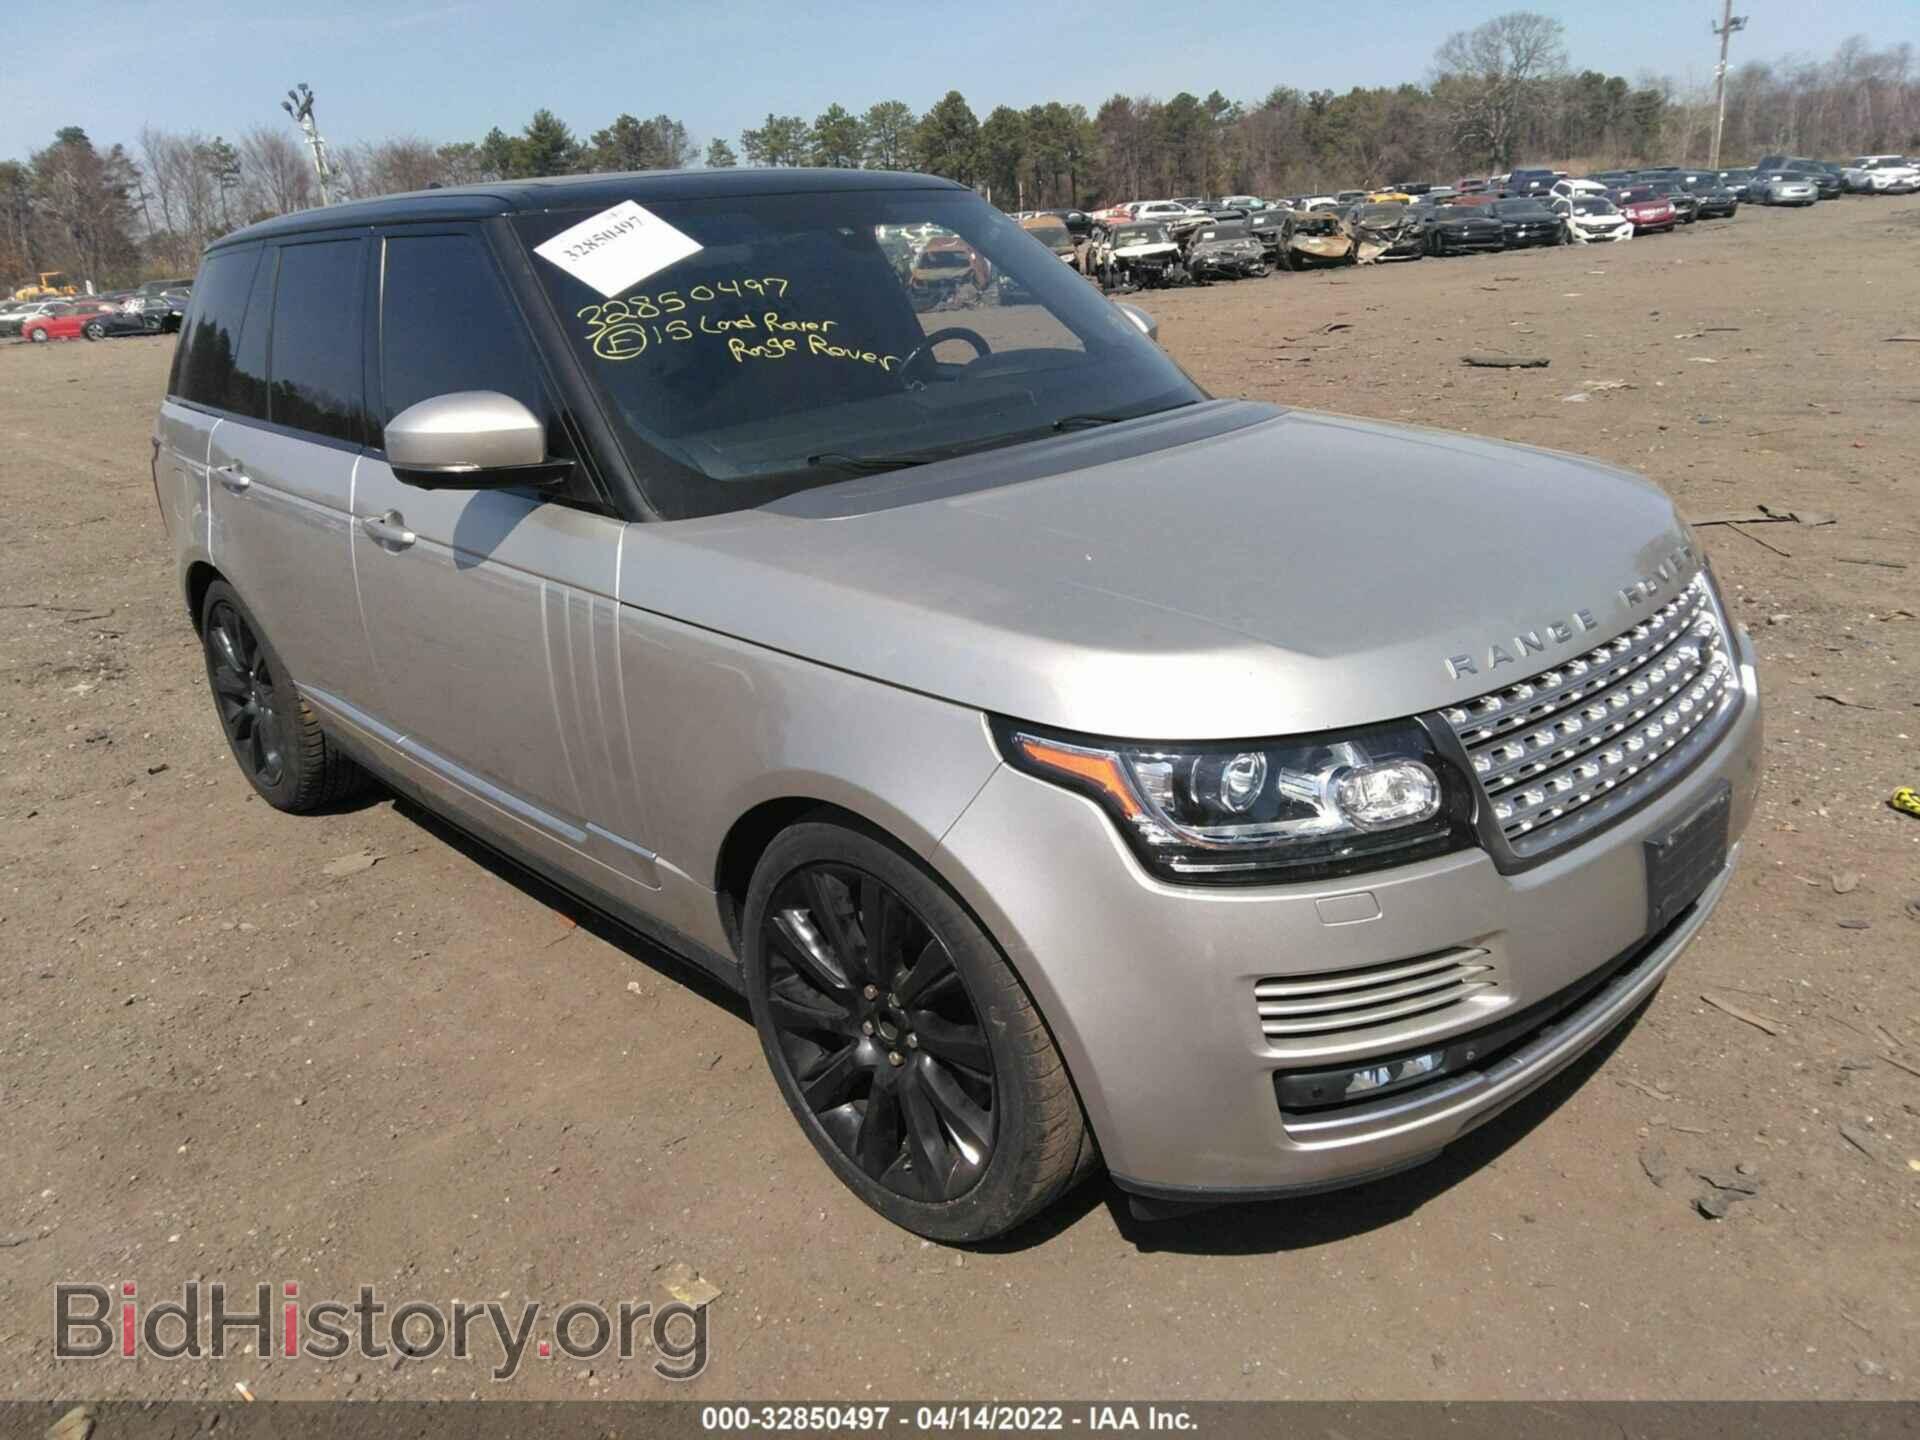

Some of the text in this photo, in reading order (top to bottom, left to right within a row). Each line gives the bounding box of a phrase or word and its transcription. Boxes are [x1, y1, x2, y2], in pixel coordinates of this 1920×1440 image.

[576, 278, 788, 340] 32850497
[728, 334, 902, 372] Range Rover
[1444, 608, 1598, 680] RANGE
